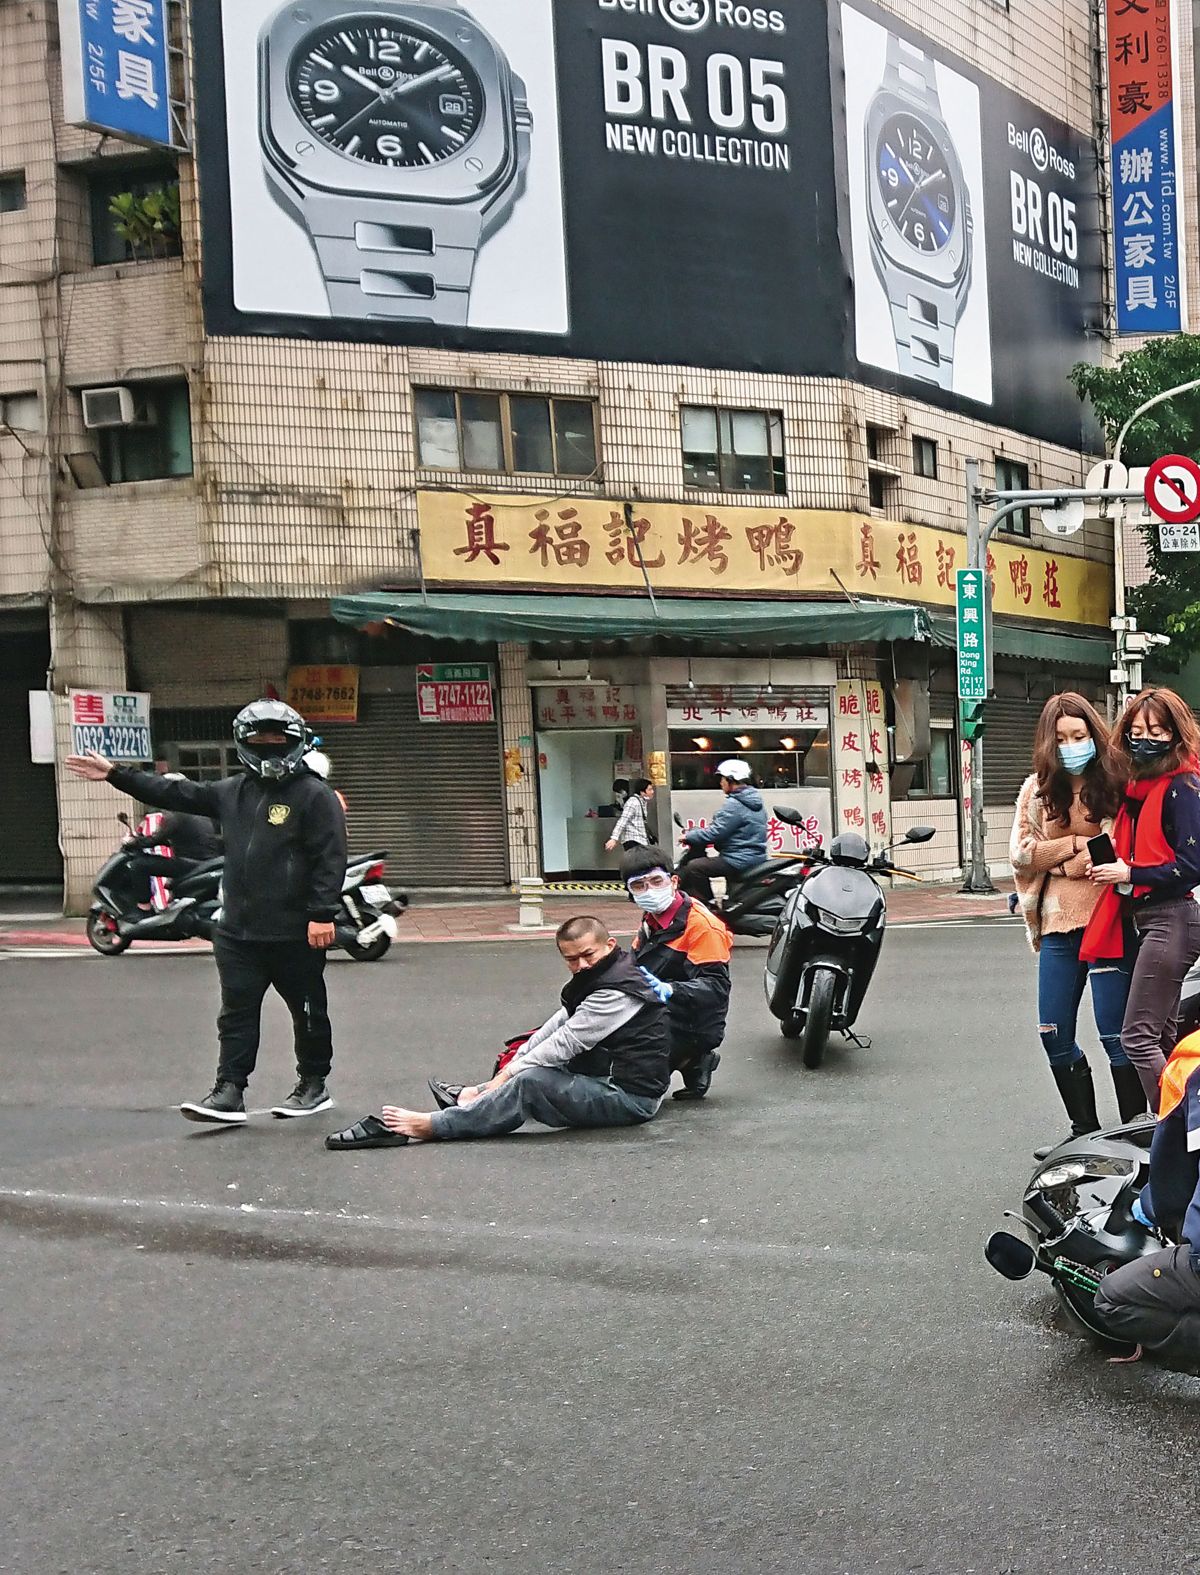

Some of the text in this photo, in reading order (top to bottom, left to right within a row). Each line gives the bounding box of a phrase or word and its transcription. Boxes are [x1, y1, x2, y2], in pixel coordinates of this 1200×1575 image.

[714, 0, 785, 31] Ross
[87, 41, 106, 94] 2/5F
[369, 38, 401, 62] 12
[1155, 16, 1169, 98] 2760-1338
[314, 79, 339, 101] 9
[601, 38, 787, 133] BR 05
[368, 118, 408, 128] AUTOMATIC
[376, 134, 402, 156] 6
[605, 123, 790, 170] NEW COLLECTION
[1007, 122, 1029, 154] Bell
[1049, 146, 1075, 180] Ross
[1159, 127, 1177, 260] www.fid.com.tw
[1010, 170, 1078, 260] BR 05
[1119, 147, 1158, 311] 辦公家具
[1013, 239, 1079, 289] NEW COLLECTION
[1163, 275, 1177, 309] 2/5F
[455, 502, 804, 577] 真福記烤鴨
[1160, 526, 1198, 537] 06-24
[1162, 537, 1200, 550] 公車除外
[962, 583, 979, 648] 東興路
[960, 651, 980, 661] Dong
[960, 660, 977, 669] Xing
[961, 676, 983, 684] 12 17
[73, 694, 104, 723] 售
[75, 726, 148, 757] 0932-322218
[839, 694, 865, 827] 脆皮烤鴨
[866, 689, 887, 835] 脆皮烤鴨
